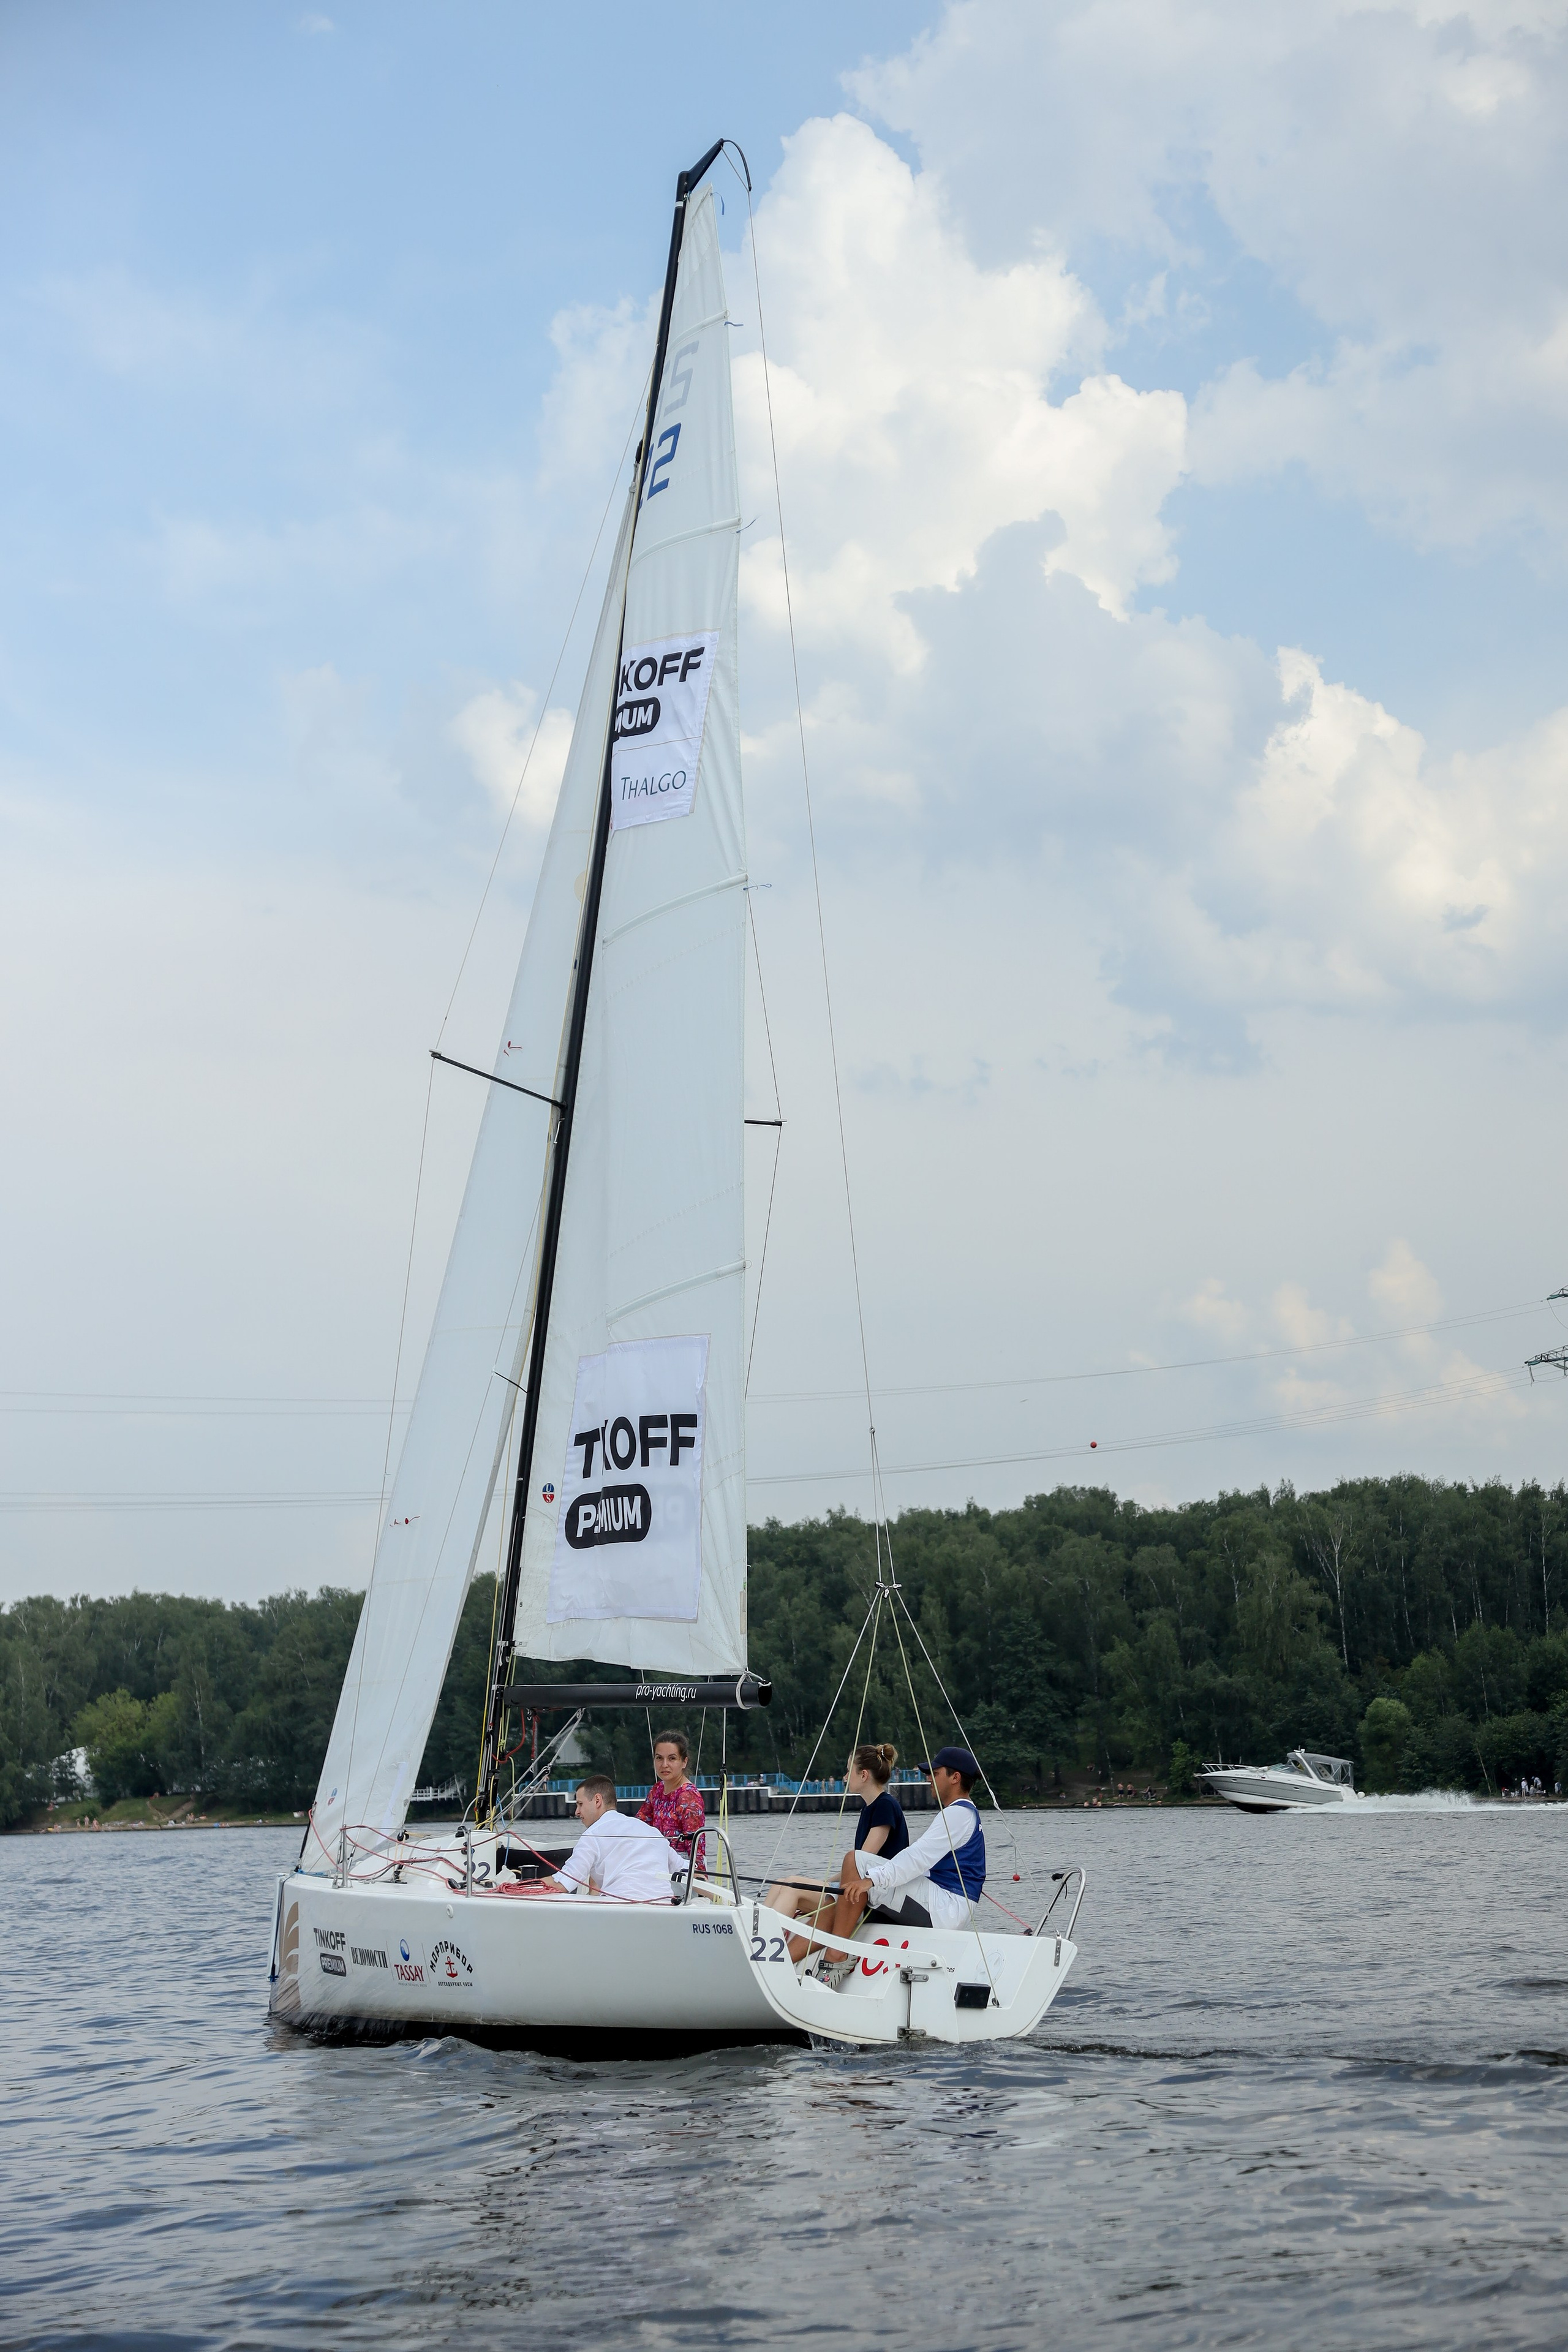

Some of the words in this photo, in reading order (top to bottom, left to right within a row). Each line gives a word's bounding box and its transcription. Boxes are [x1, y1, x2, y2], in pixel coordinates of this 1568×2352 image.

[620, 770, 687, 801] THALGO
[635, 1683, 698, 1702] pro-yachting.ru
[313, 1928, 346, 1951] TINKOFF
[692, 1923, 710, 1934] RUS
[712, 1924, 734, 1934] 1068
[350, 1947, 388, 1969] ВЕДОМОСТИ
[429, 1940, 473, 1973] МОРПРИБОР
[750, 1936, 785, 1962] 22
[321, 1956, 345, 1973] PREMIUM
[394, 1964, 424, 1981] TASSAY
